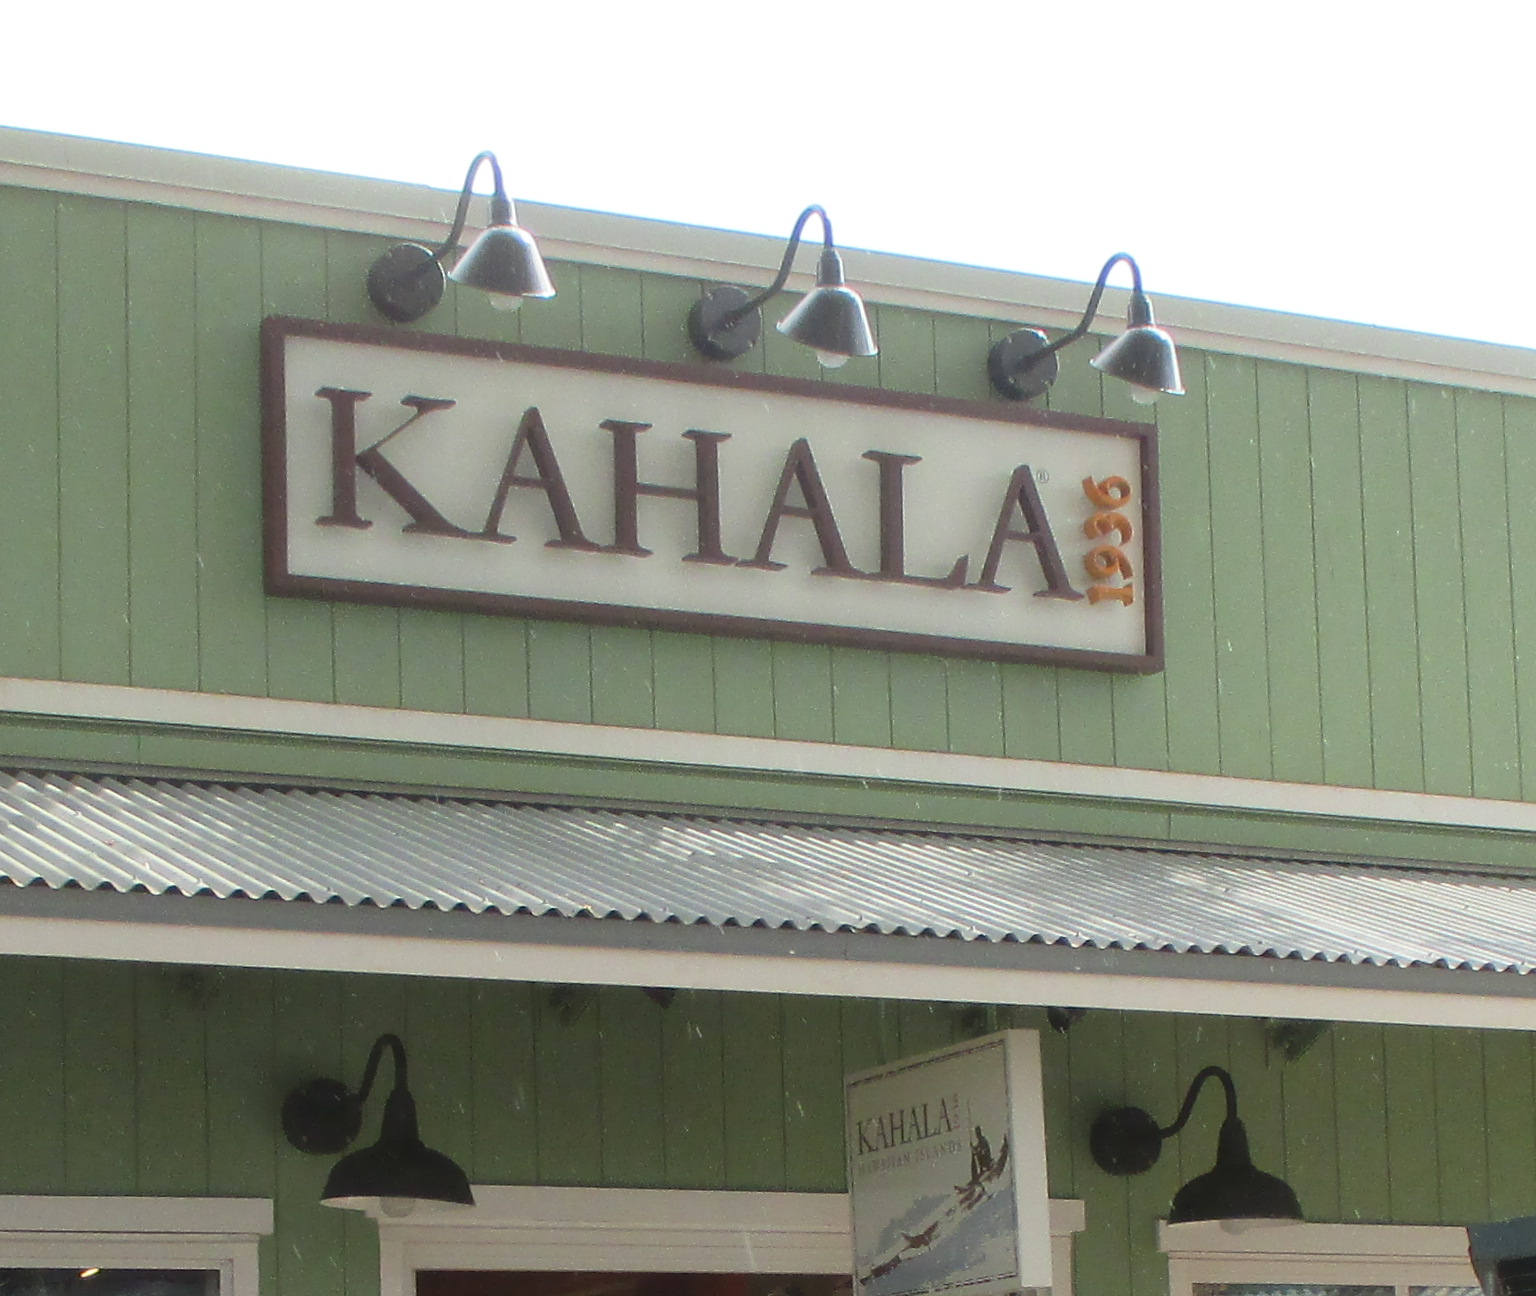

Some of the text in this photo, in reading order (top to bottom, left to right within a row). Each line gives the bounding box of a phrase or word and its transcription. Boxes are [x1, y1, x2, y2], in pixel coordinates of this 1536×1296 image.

[314, 386, 1086, 602] KAHALA
[1082, 475, 1134, 607] 1936
[856, 1097, 952, 1156] KAHALA
